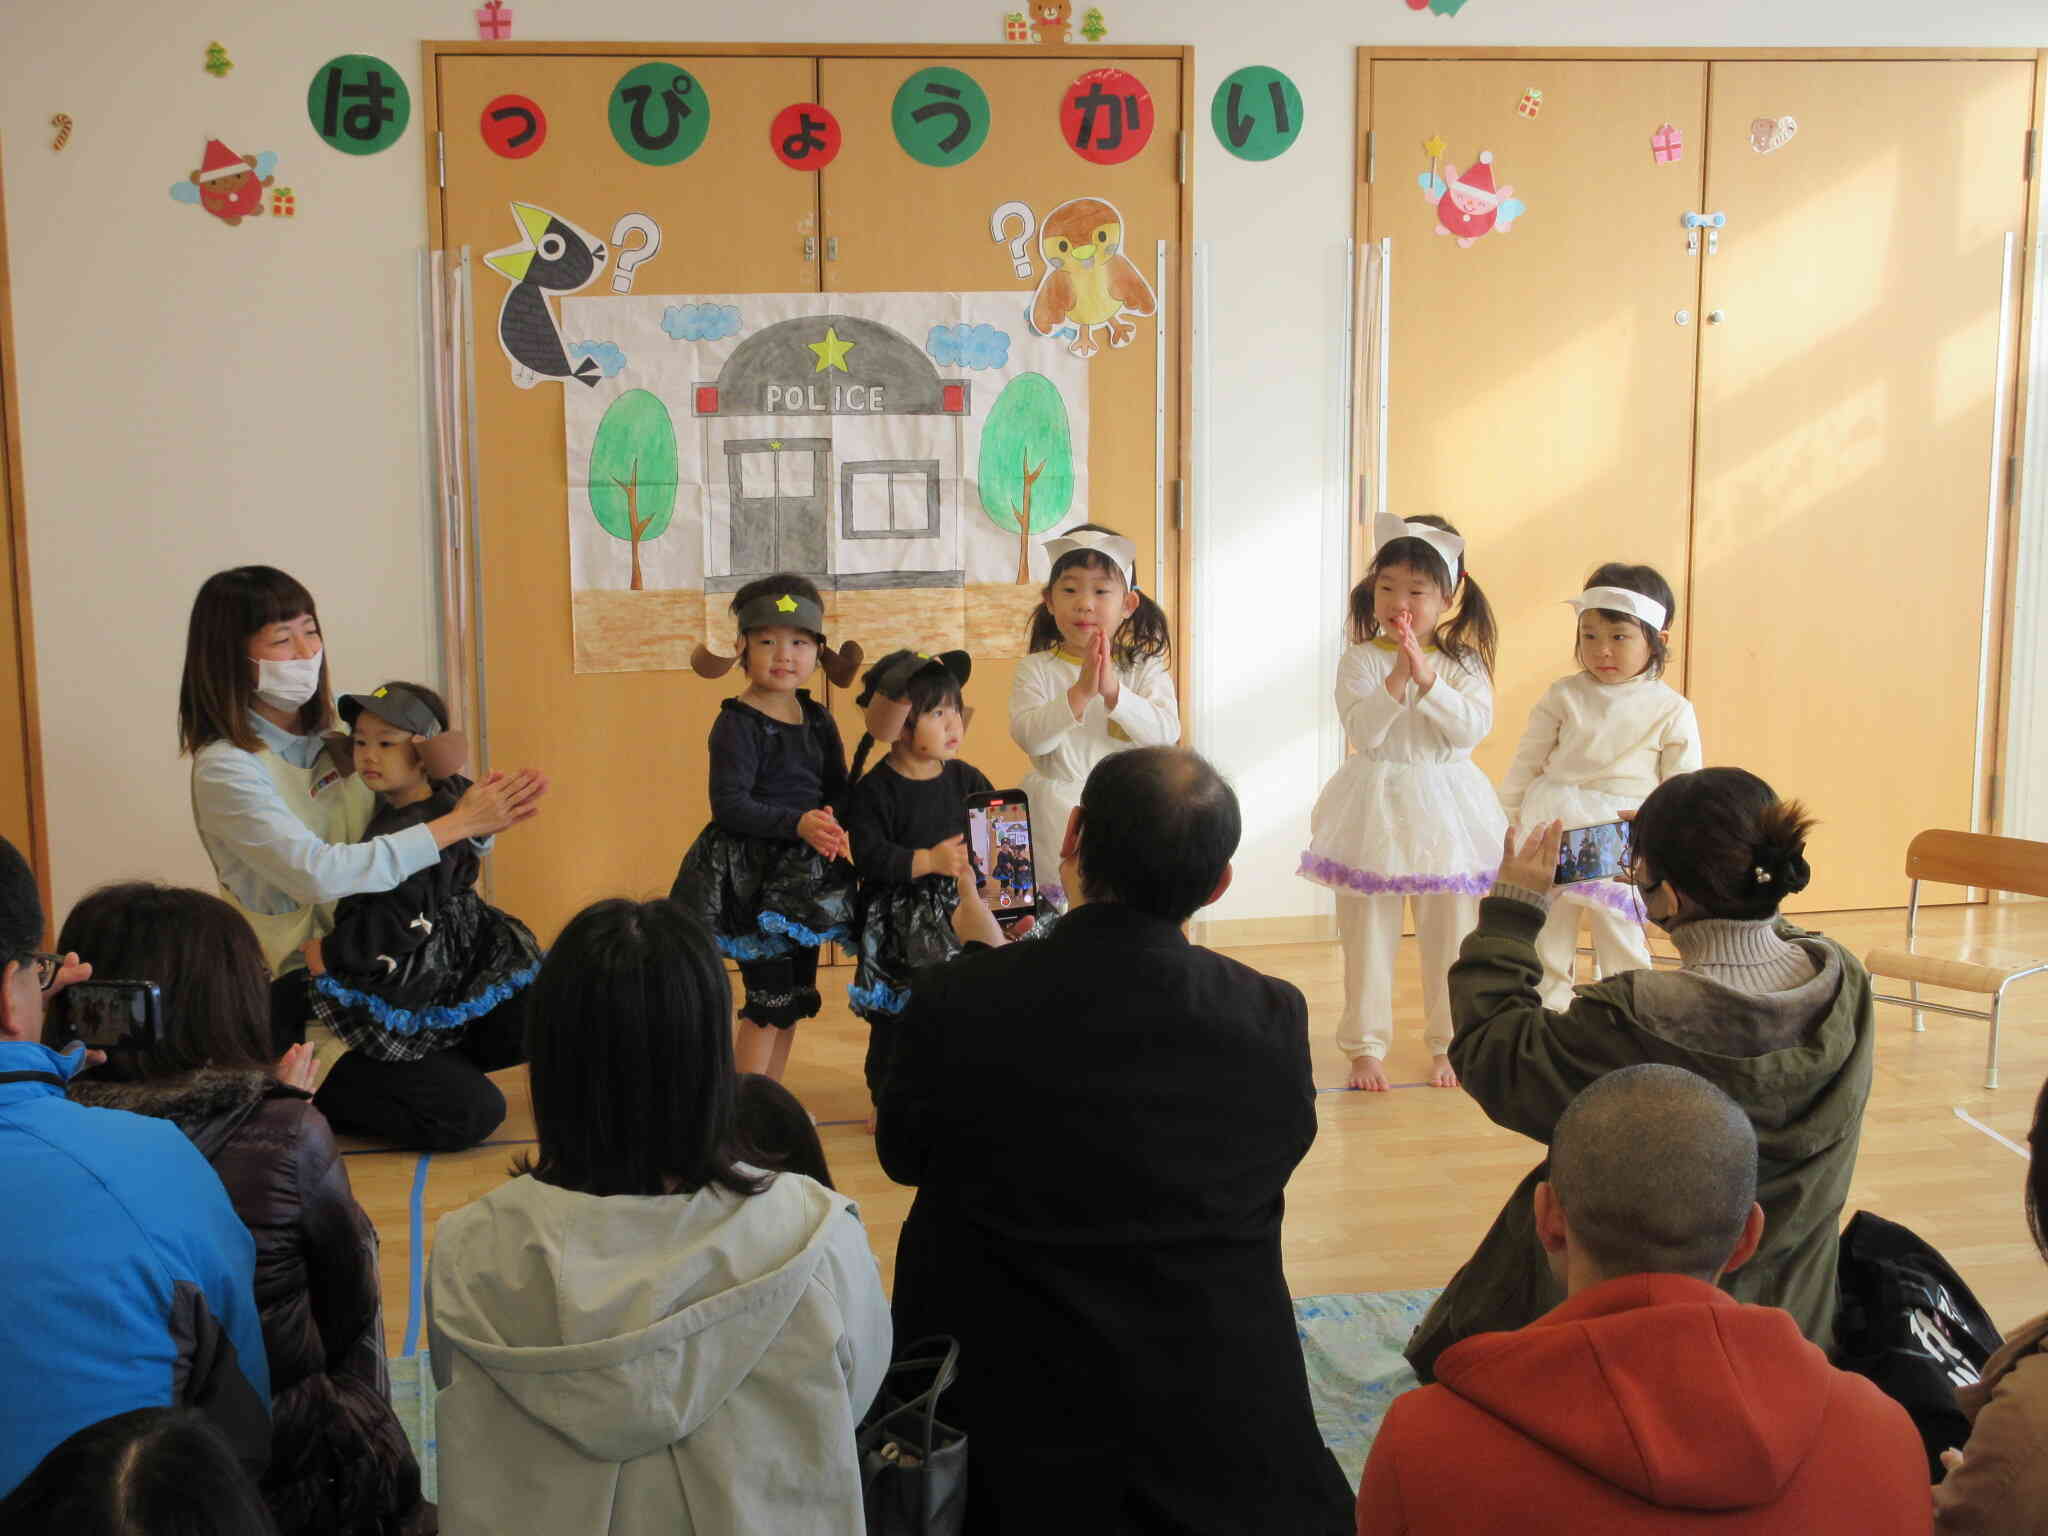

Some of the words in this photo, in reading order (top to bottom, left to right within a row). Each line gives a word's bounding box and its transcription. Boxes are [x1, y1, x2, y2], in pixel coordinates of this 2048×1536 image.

[323, 67, 1290, 159] はっぴょうかい
[766, 384, 886, 412] POLICE
